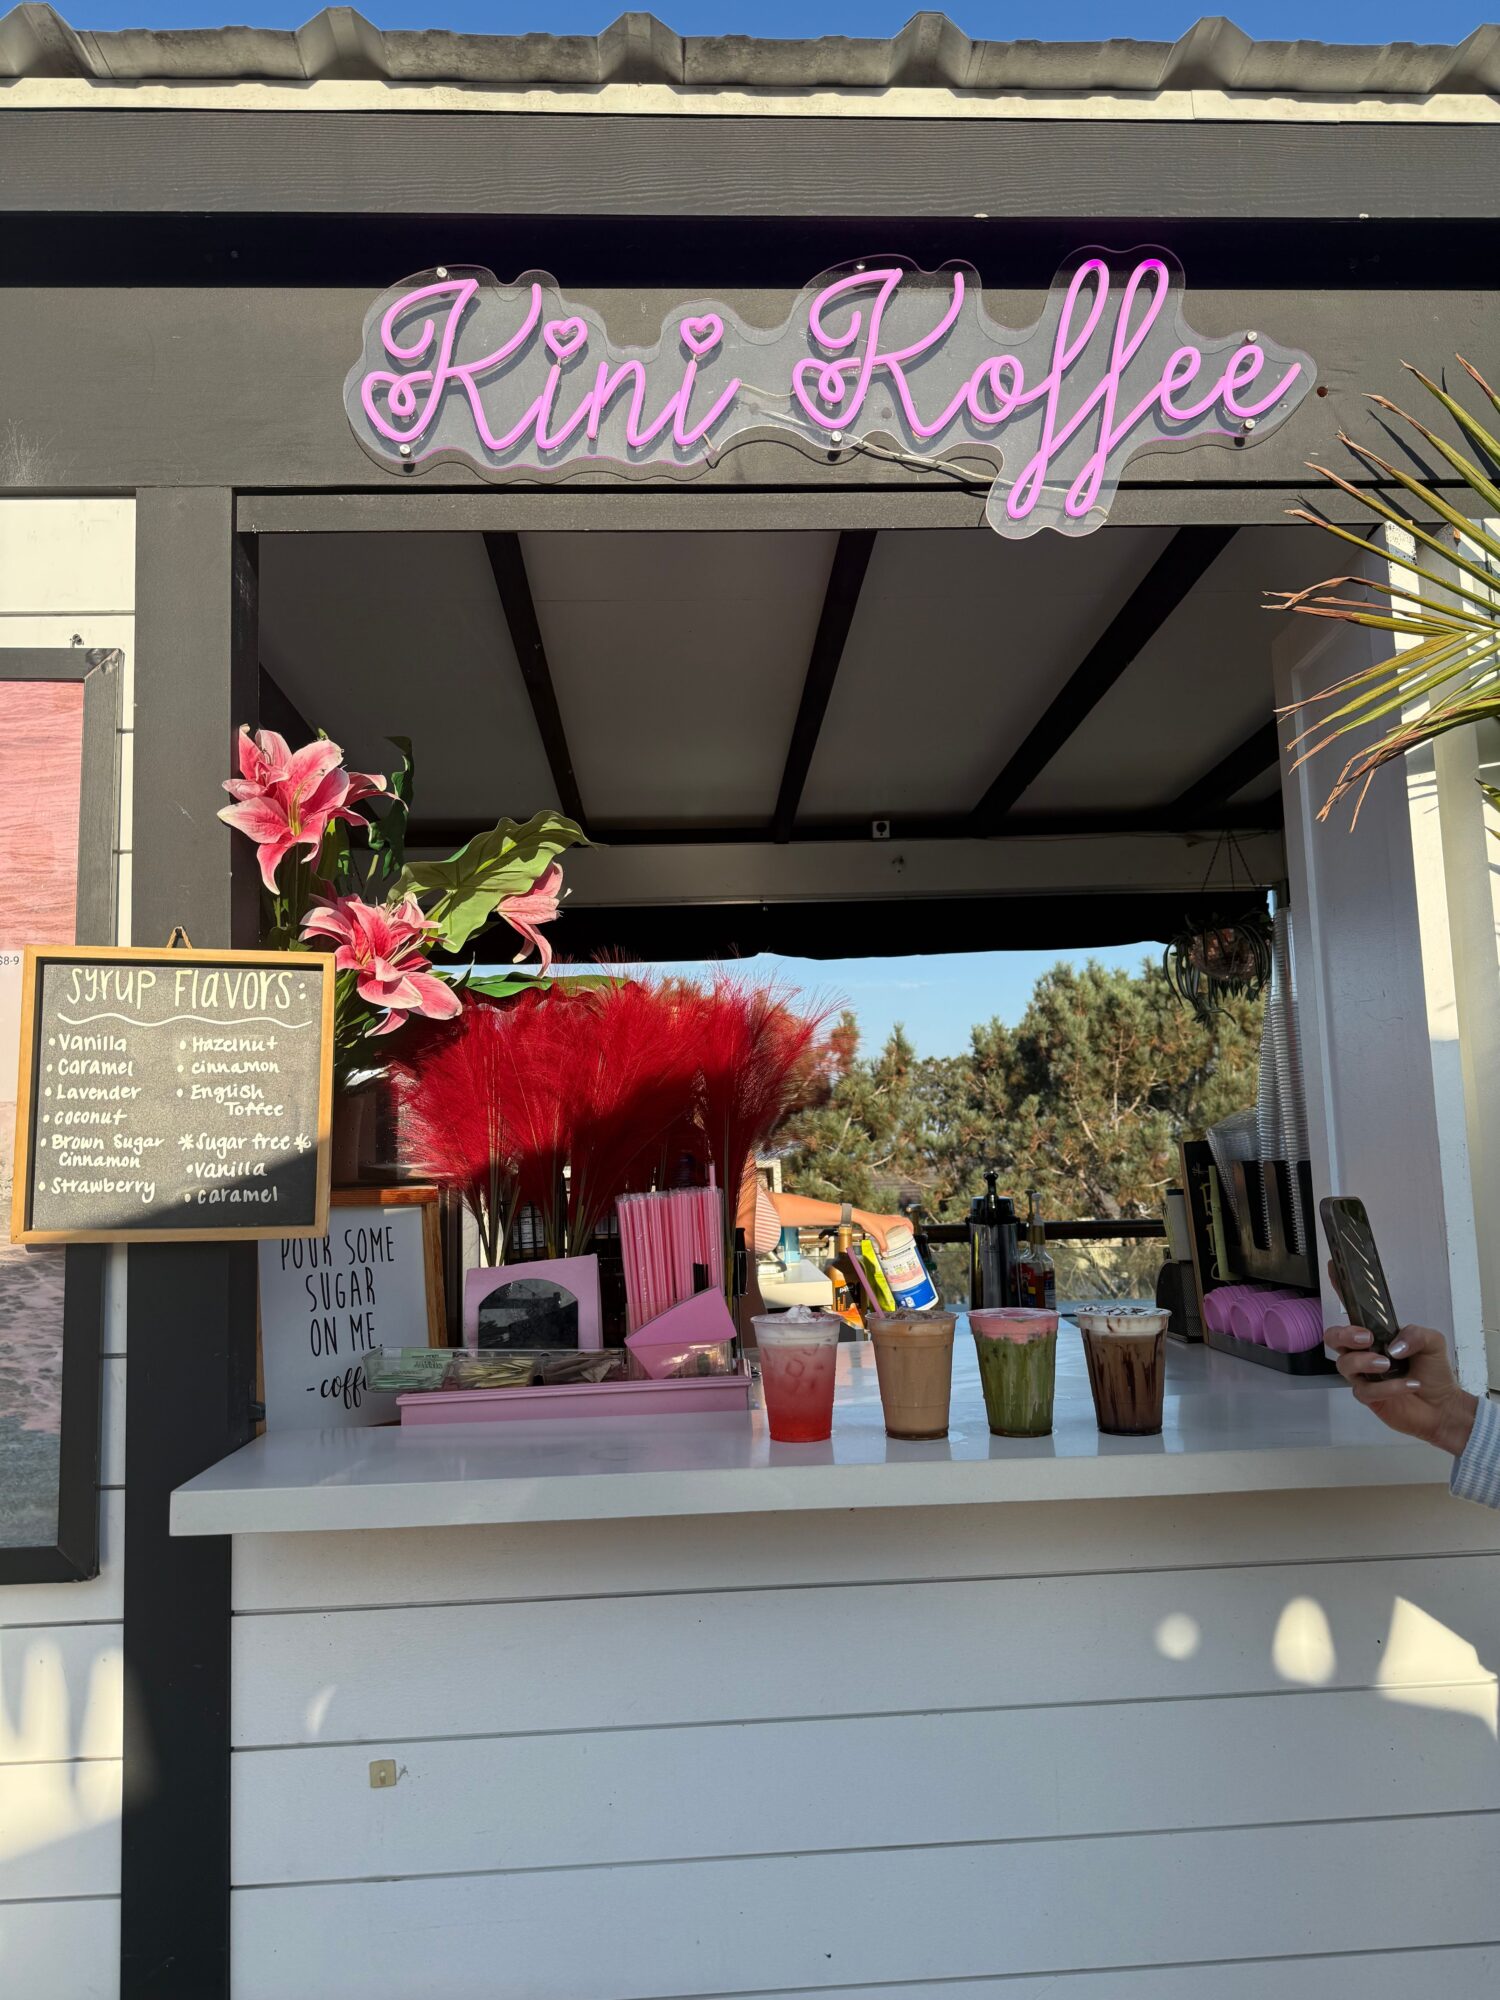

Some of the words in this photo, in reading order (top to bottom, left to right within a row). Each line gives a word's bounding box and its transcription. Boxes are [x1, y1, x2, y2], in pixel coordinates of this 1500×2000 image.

[361, 278, 742, 450] Kini
[792, 258, 1302, 519] Koffee
[59, 1033, 128, 1052] Vanilla
[192, 1035, 279, 1053] Hazelnut
[57, 1058, 134, 1077] Caramel
[56, 1083, 142, 1101] Lavender
[190, 1083, 265, 1104] English
[223, 1101, 284, 1117] Toffee
[51, 1134, 105, 1150] Brown
[113, 1133, 166, 1156] Sugar
[58, 1151, 141, 1169] Cinnamon
[194, 1161, 268, 1179] Vanilla
[51, 1177, 156, 1204] Strawberry
[281, 1234, 332, 1271] POUR
[344, 1226, 395, 1266] SOME
[305, 1266, 376, 1313] SUGAR
[310, 1316, 338, 1357] ON
